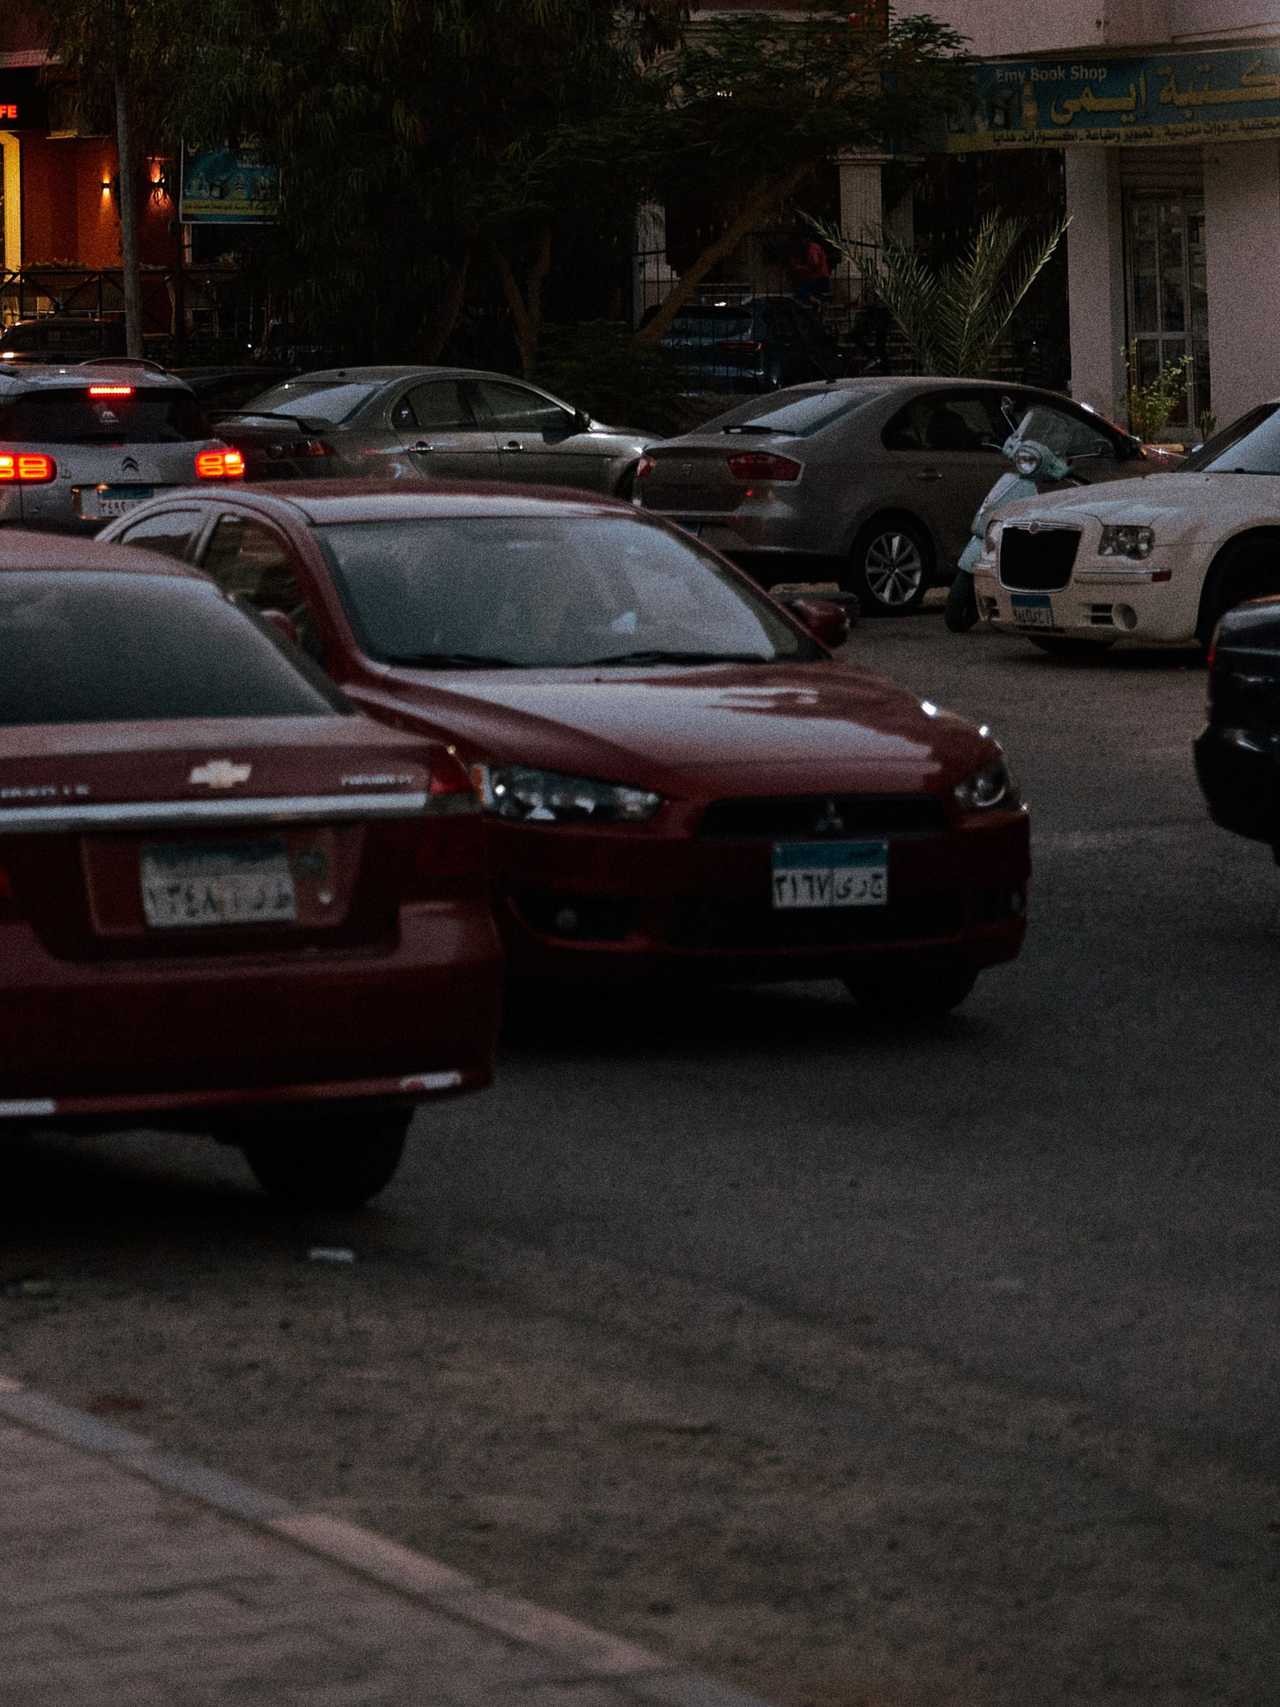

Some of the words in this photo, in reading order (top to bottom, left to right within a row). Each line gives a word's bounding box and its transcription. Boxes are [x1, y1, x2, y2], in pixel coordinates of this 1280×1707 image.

[996, 68, 1025, 83] Emy
[1030, 66, 1066, 81] Book
[1070, 64, 1107, 82] Shop
[1157, 58, 1280, 120] كتبة
